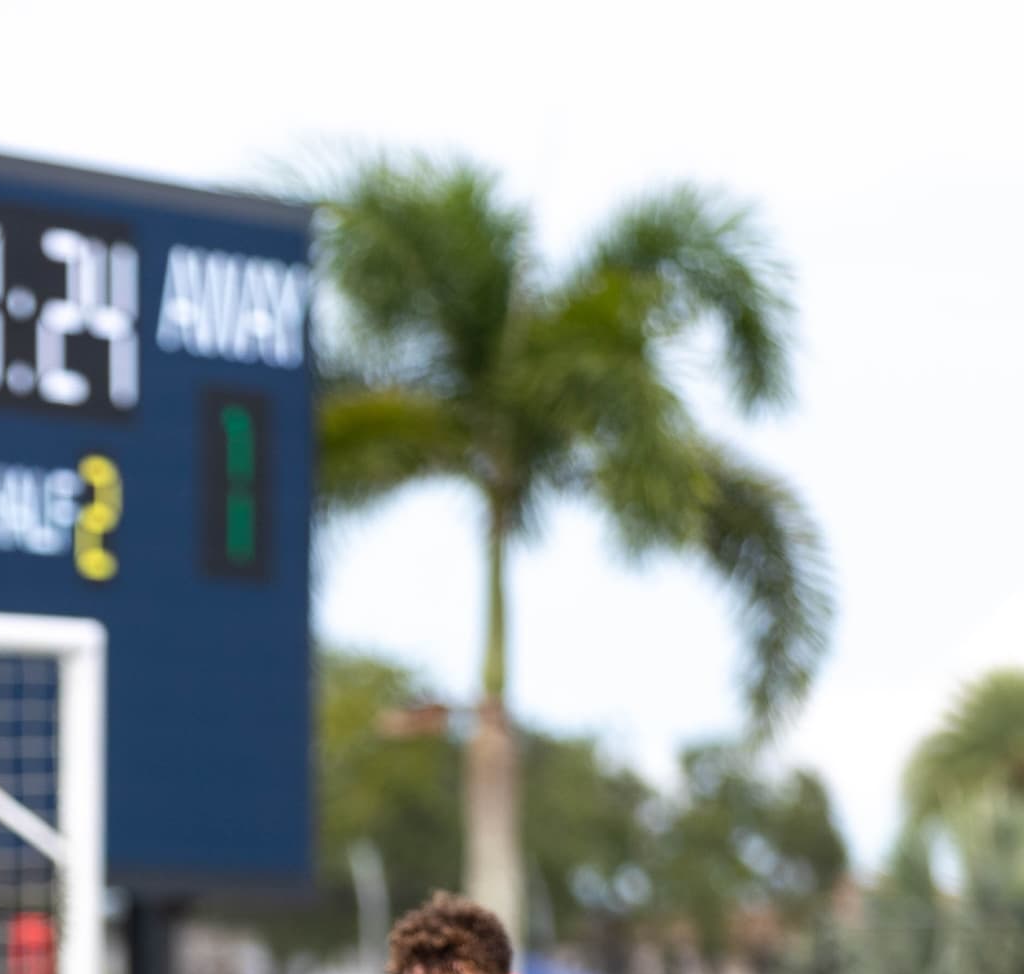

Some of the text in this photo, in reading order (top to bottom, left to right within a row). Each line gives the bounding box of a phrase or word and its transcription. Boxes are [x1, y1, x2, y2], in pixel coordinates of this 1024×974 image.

[156, 244, 308, 369] AWAY
[74, 454, 123, 582] 2
[222, 403, 254, 566] 1
